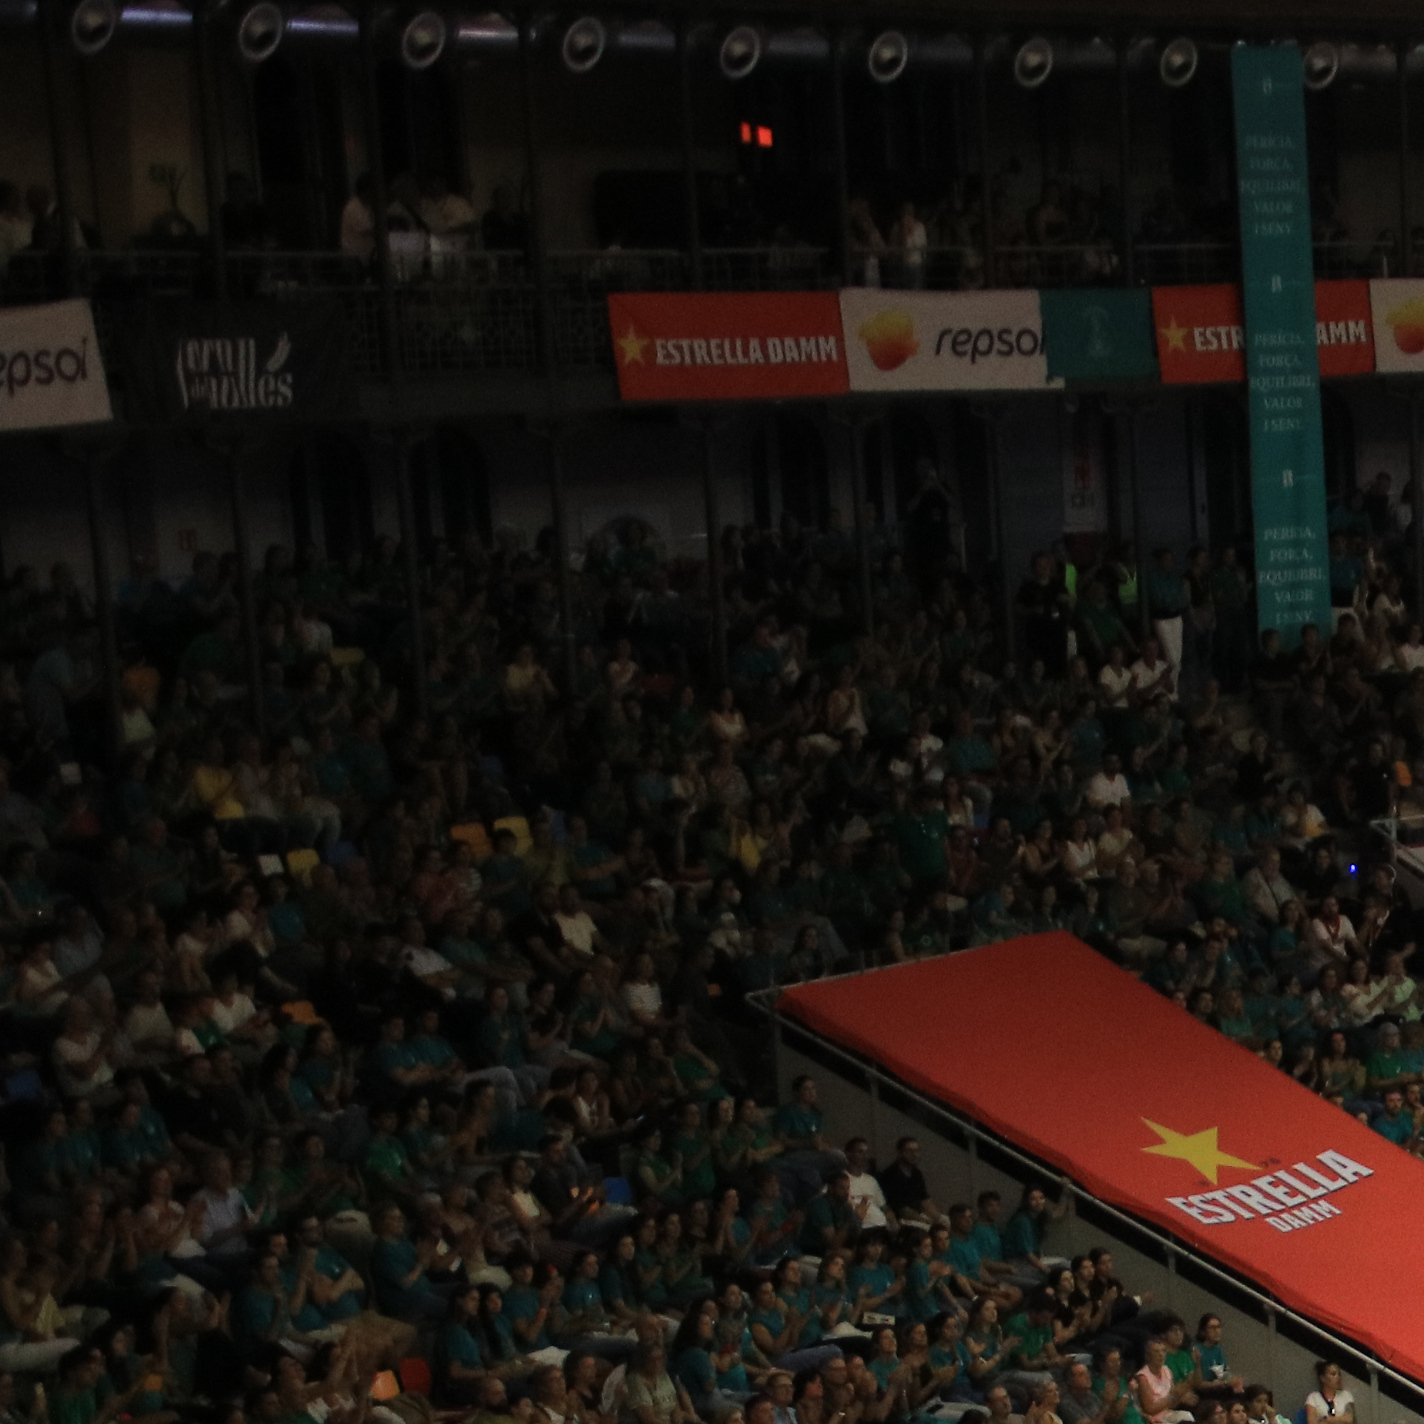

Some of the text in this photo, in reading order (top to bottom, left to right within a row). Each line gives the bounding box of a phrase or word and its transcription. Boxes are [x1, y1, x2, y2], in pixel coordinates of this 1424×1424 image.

[1315, 319, 1367, 345] AMM
[656, 335, 838, 365] ESTRELLA DAMM
[1165, 1149, 1375, 1225] ESTRELLA
[1265, 1200, 1343, 1234] DAMM
